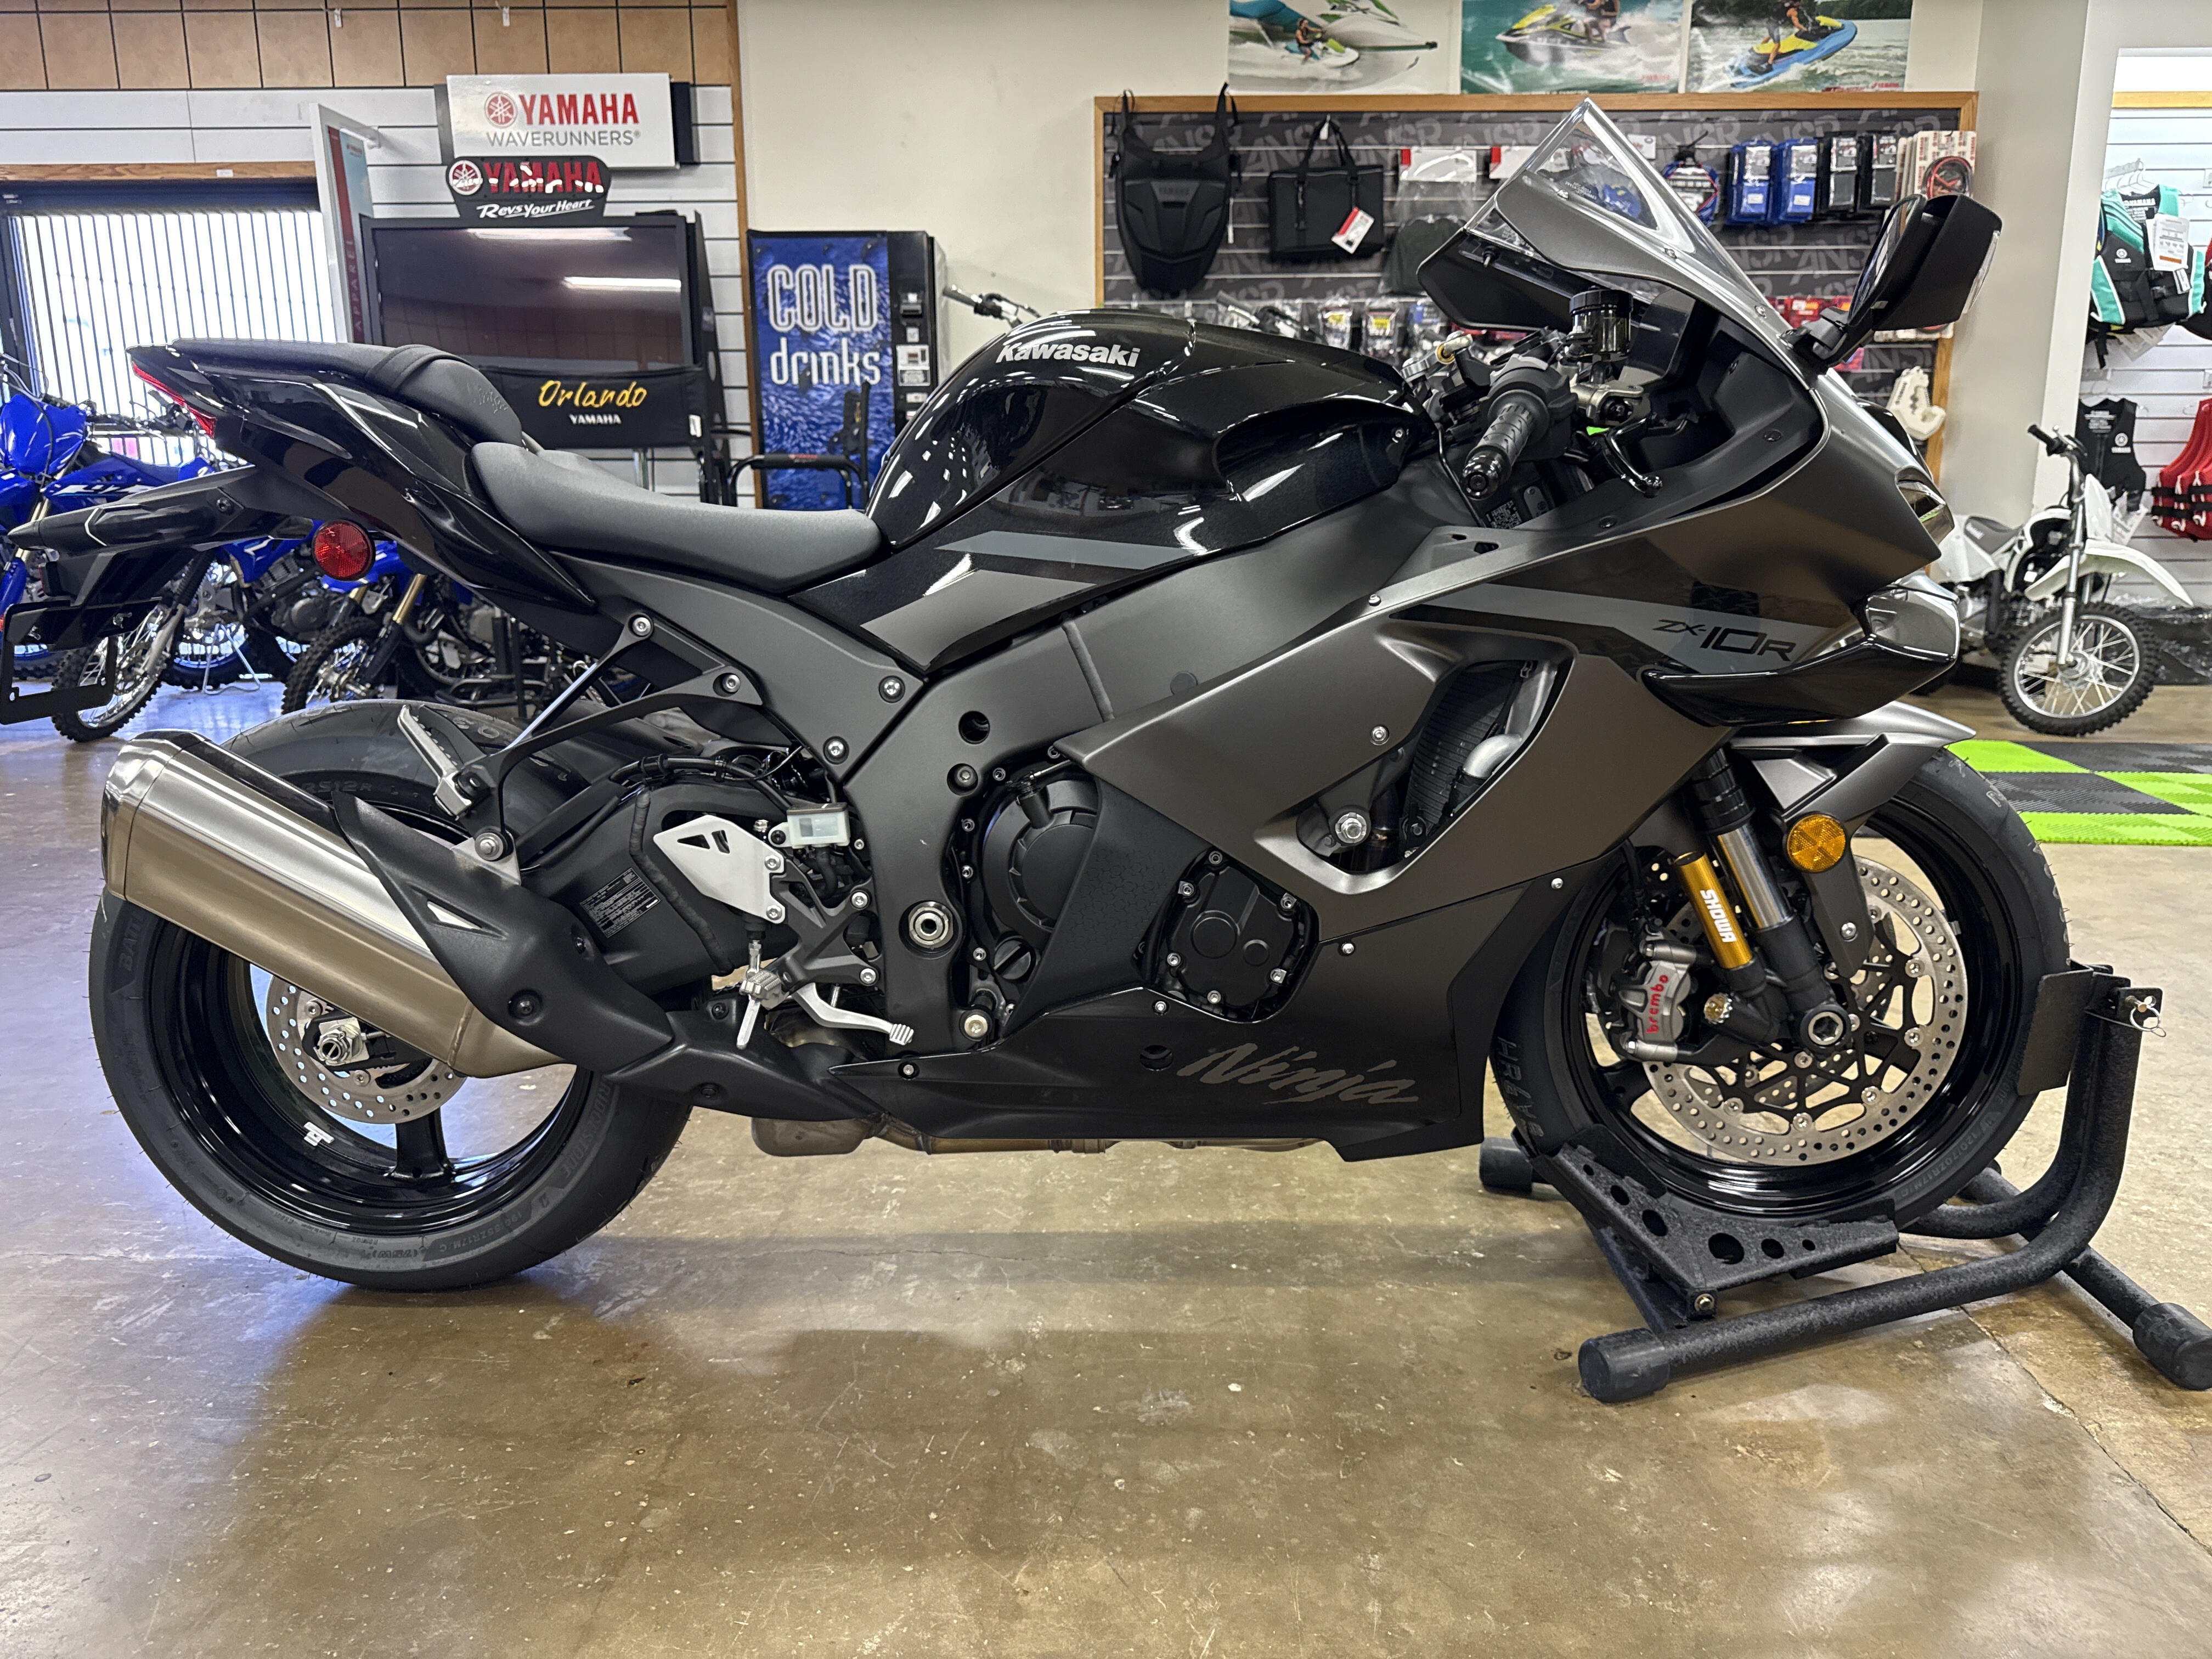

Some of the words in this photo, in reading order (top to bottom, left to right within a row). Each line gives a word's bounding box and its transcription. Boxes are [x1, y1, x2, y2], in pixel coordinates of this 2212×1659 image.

[519, 93, 640, 125] YAMAHA
[484, 161, 603, 194] YAMAHA
[477, 204, 523, 218] Revs
[524, 203, 556, 218] Your
[556, 199, 594, 212] Heart
[768, 264, 878, 332] COLD
[771, 337, 881, 386] drinks
[995, 342, 1140, 368] Kawasaki
[538, 381, 647, 409] Orlando
[569, 414, 622, 425] YAMAHA
[1653, 619, 1796, 661] ZX-10R
[1700, 889, 1737, 943] SHOWA
[1645, 974, 1668, 1034] brembo
[1177, 1042, 1419, 1105] Ninja
